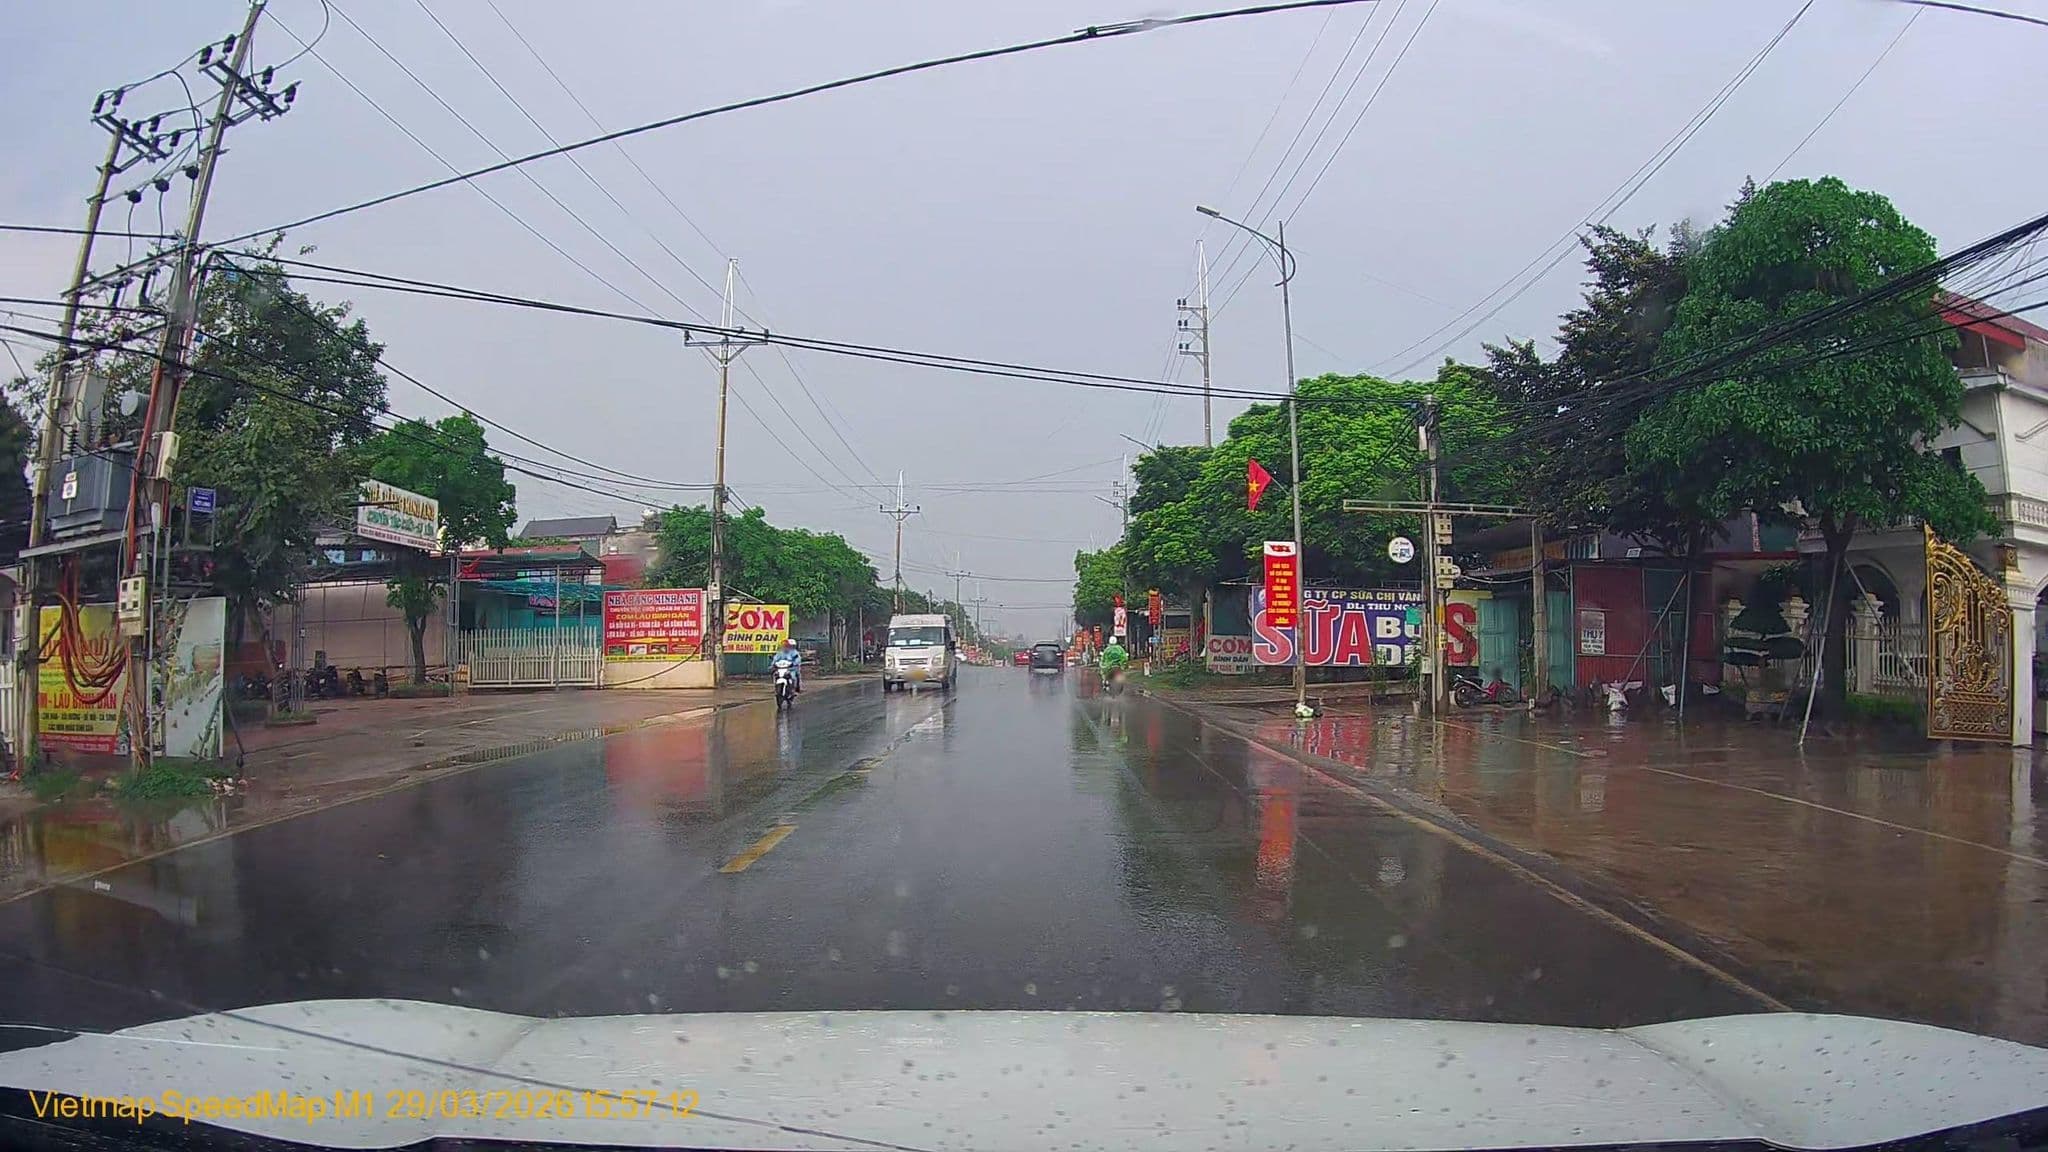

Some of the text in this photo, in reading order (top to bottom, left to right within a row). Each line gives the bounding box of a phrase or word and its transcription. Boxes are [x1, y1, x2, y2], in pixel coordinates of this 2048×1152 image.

[608, 592, 698, 606] NHÀ HÀNG MINH ANH
[1315, 590, 1329, 599] TY
[1332, 590, 1347, 600] CP
[1376, 592, 1396, 603] CHỊ
[728, 632, 778, 641] BÌNH DÂN
[1253, 599, 1375, 666] SỮA
[1208, 636, 1253, 653] CƠM
